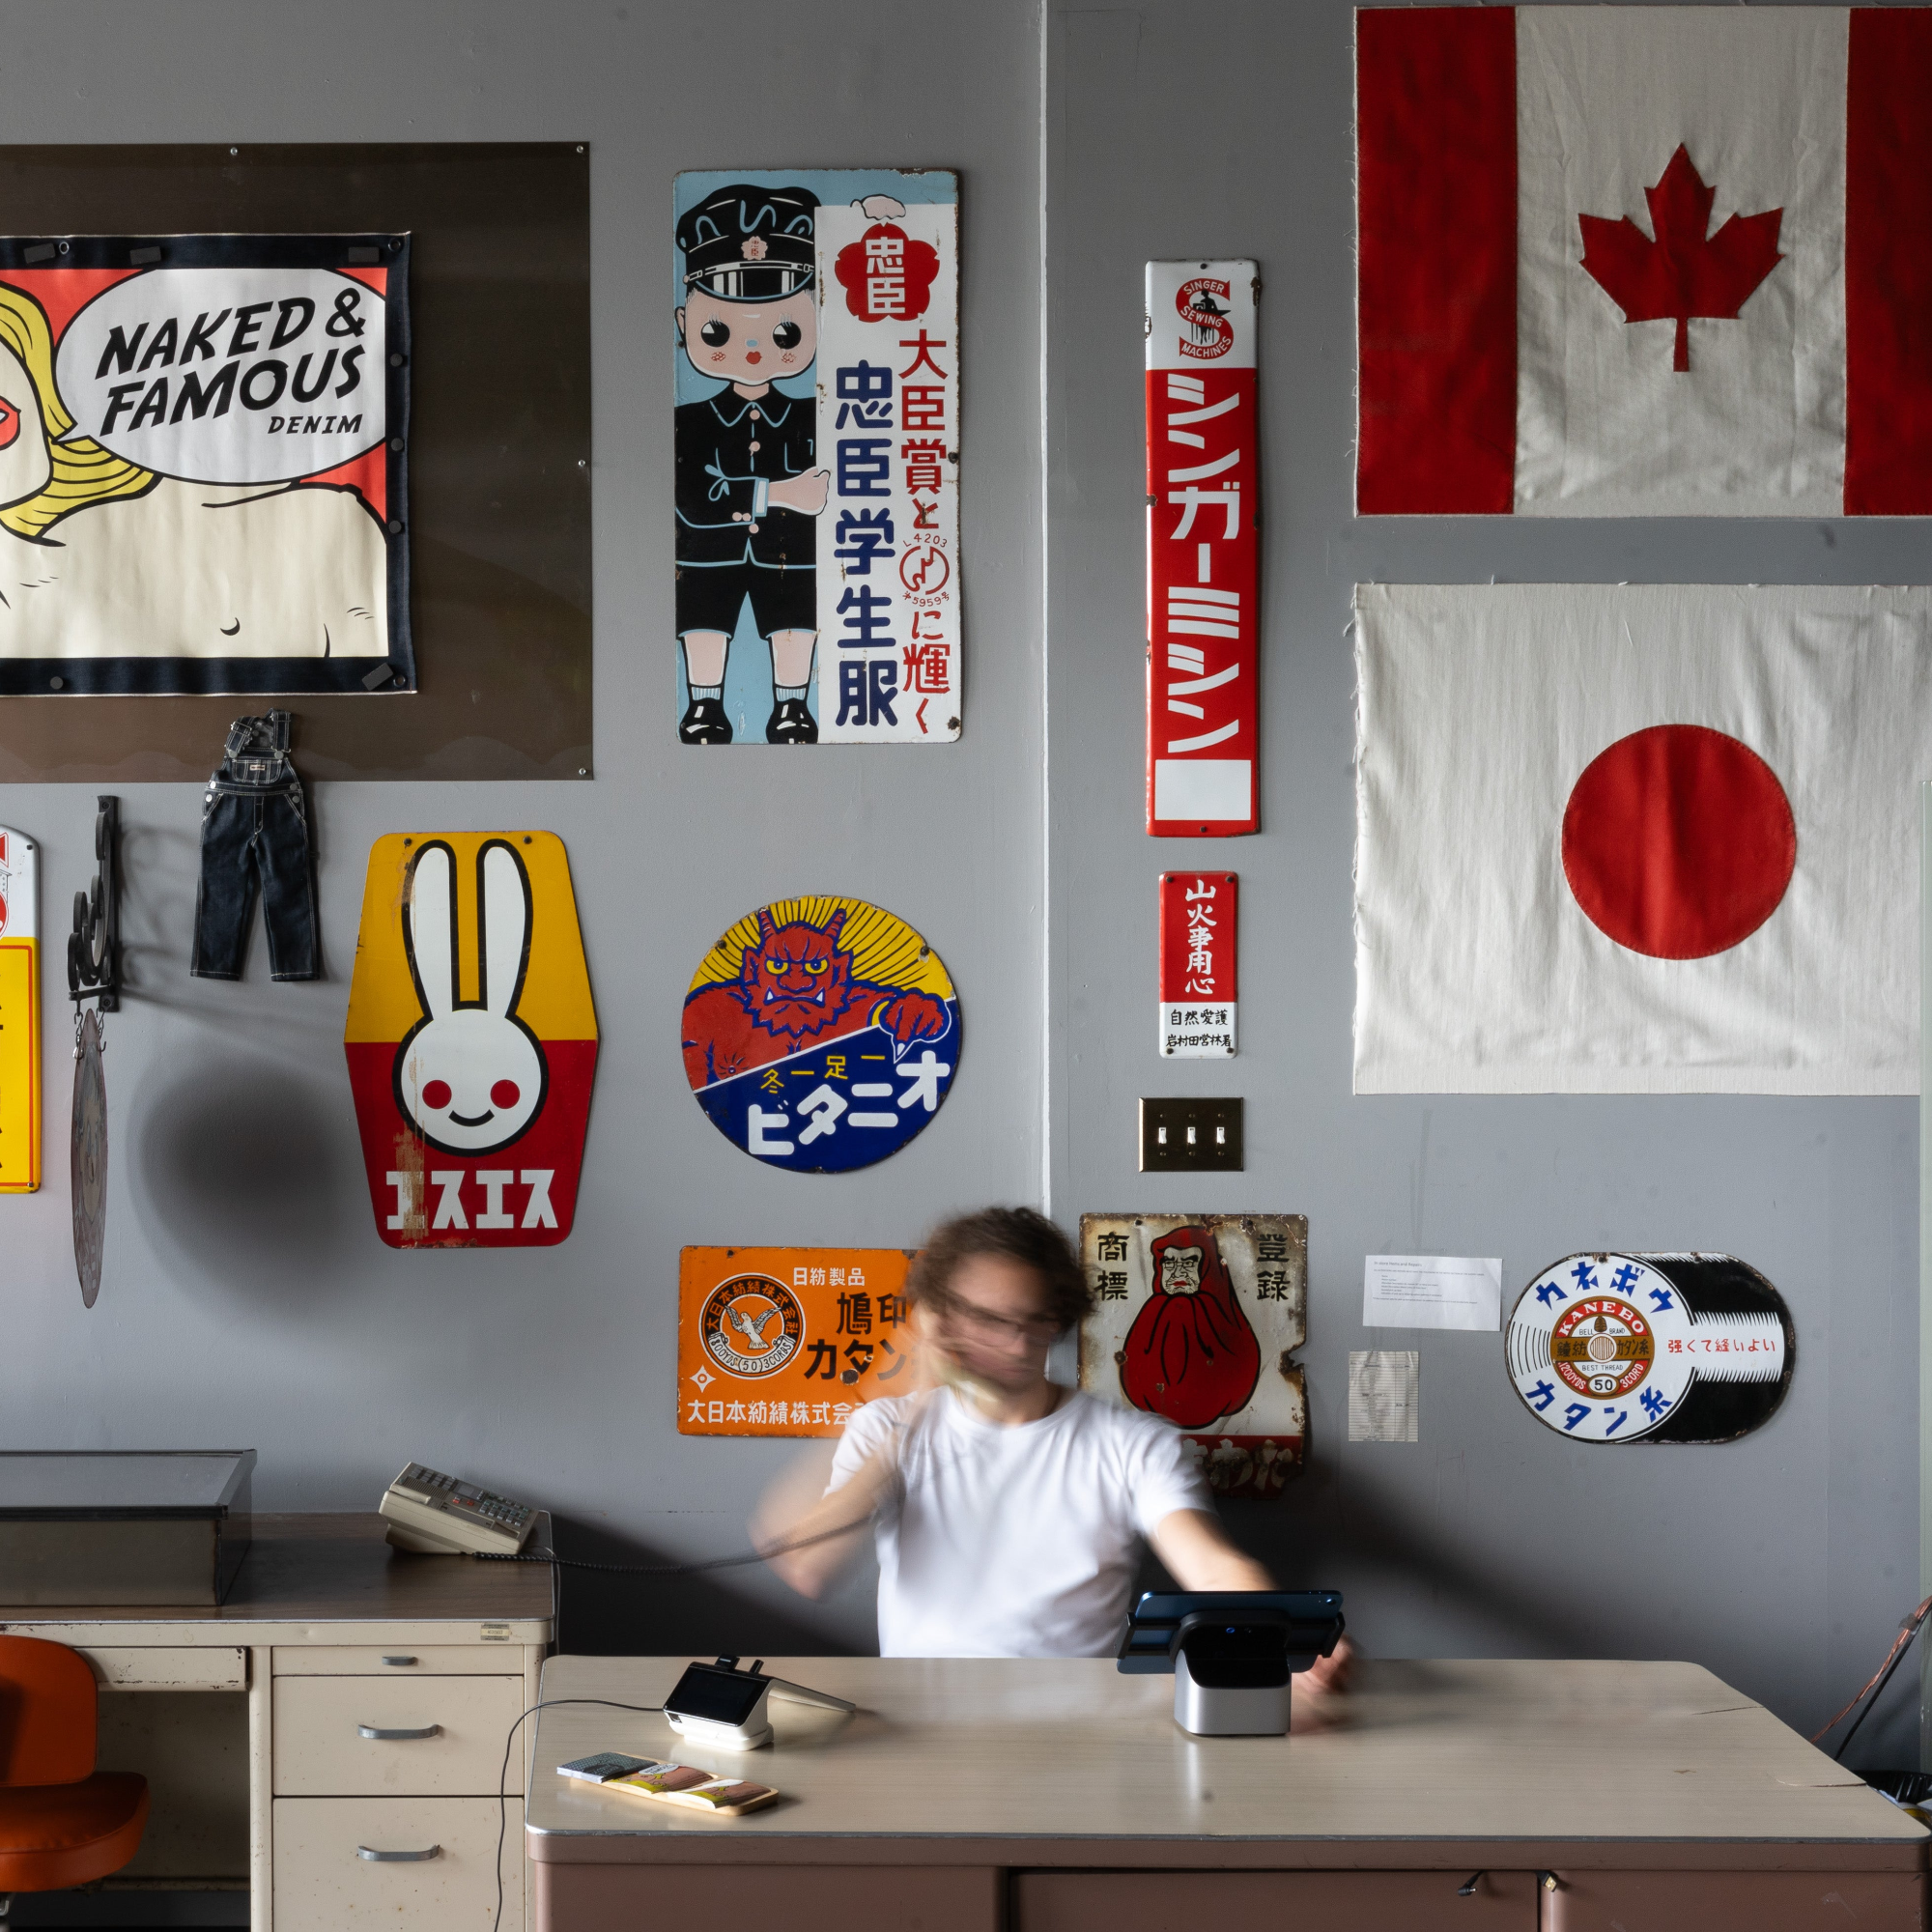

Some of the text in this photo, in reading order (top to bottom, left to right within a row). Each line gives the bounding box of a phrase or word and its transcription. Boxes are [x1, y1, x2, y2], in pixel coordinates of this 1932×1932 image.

[866, 236, 906, 314] 忠臣
[1183, 280, 1225, 295] SINGER
[95, 288, 366, 381] NAKED &
[1180, 305, 1223, 327] SEWING
[1181, 335, 1232, 357] MACHINES
[99, 344, 366, 438] FAMOUS
[268, 413, 363, 435] DENIM
[834, 359, 898, 726] 忠臣学生服
[1167, 373, 1240, 753] シンガーミシン
[1184, 879, 1217, 995] 山火事用心
[385, 1169, 559, 1230] エスエス
[792, 1267, 866, 1287] 日紡製品
[1094, 1231, 1130, 1301] 商標
[1535, 1261, 1675, 1314] カネボウ
[836, 1292, 907, 1335] 鳩印
[1558, 1300, 1645, 1336] KANEBO
[763, 1342, 792, 1369] 3CORDS
[804, 1339, 924, 1381] カタン
[1667, 1339, 1776, 1353] 強くて縫いよい
[743, 1360, 757, 1372] 50
[1594, 1378, 1613, 1391] 50
[1619, 1362, 1644, 1388] 3CORD
[687, 1399, 866, 1426] 大日本紡績株式会
[1525, 1378, 1673, 1437] カタン糸
